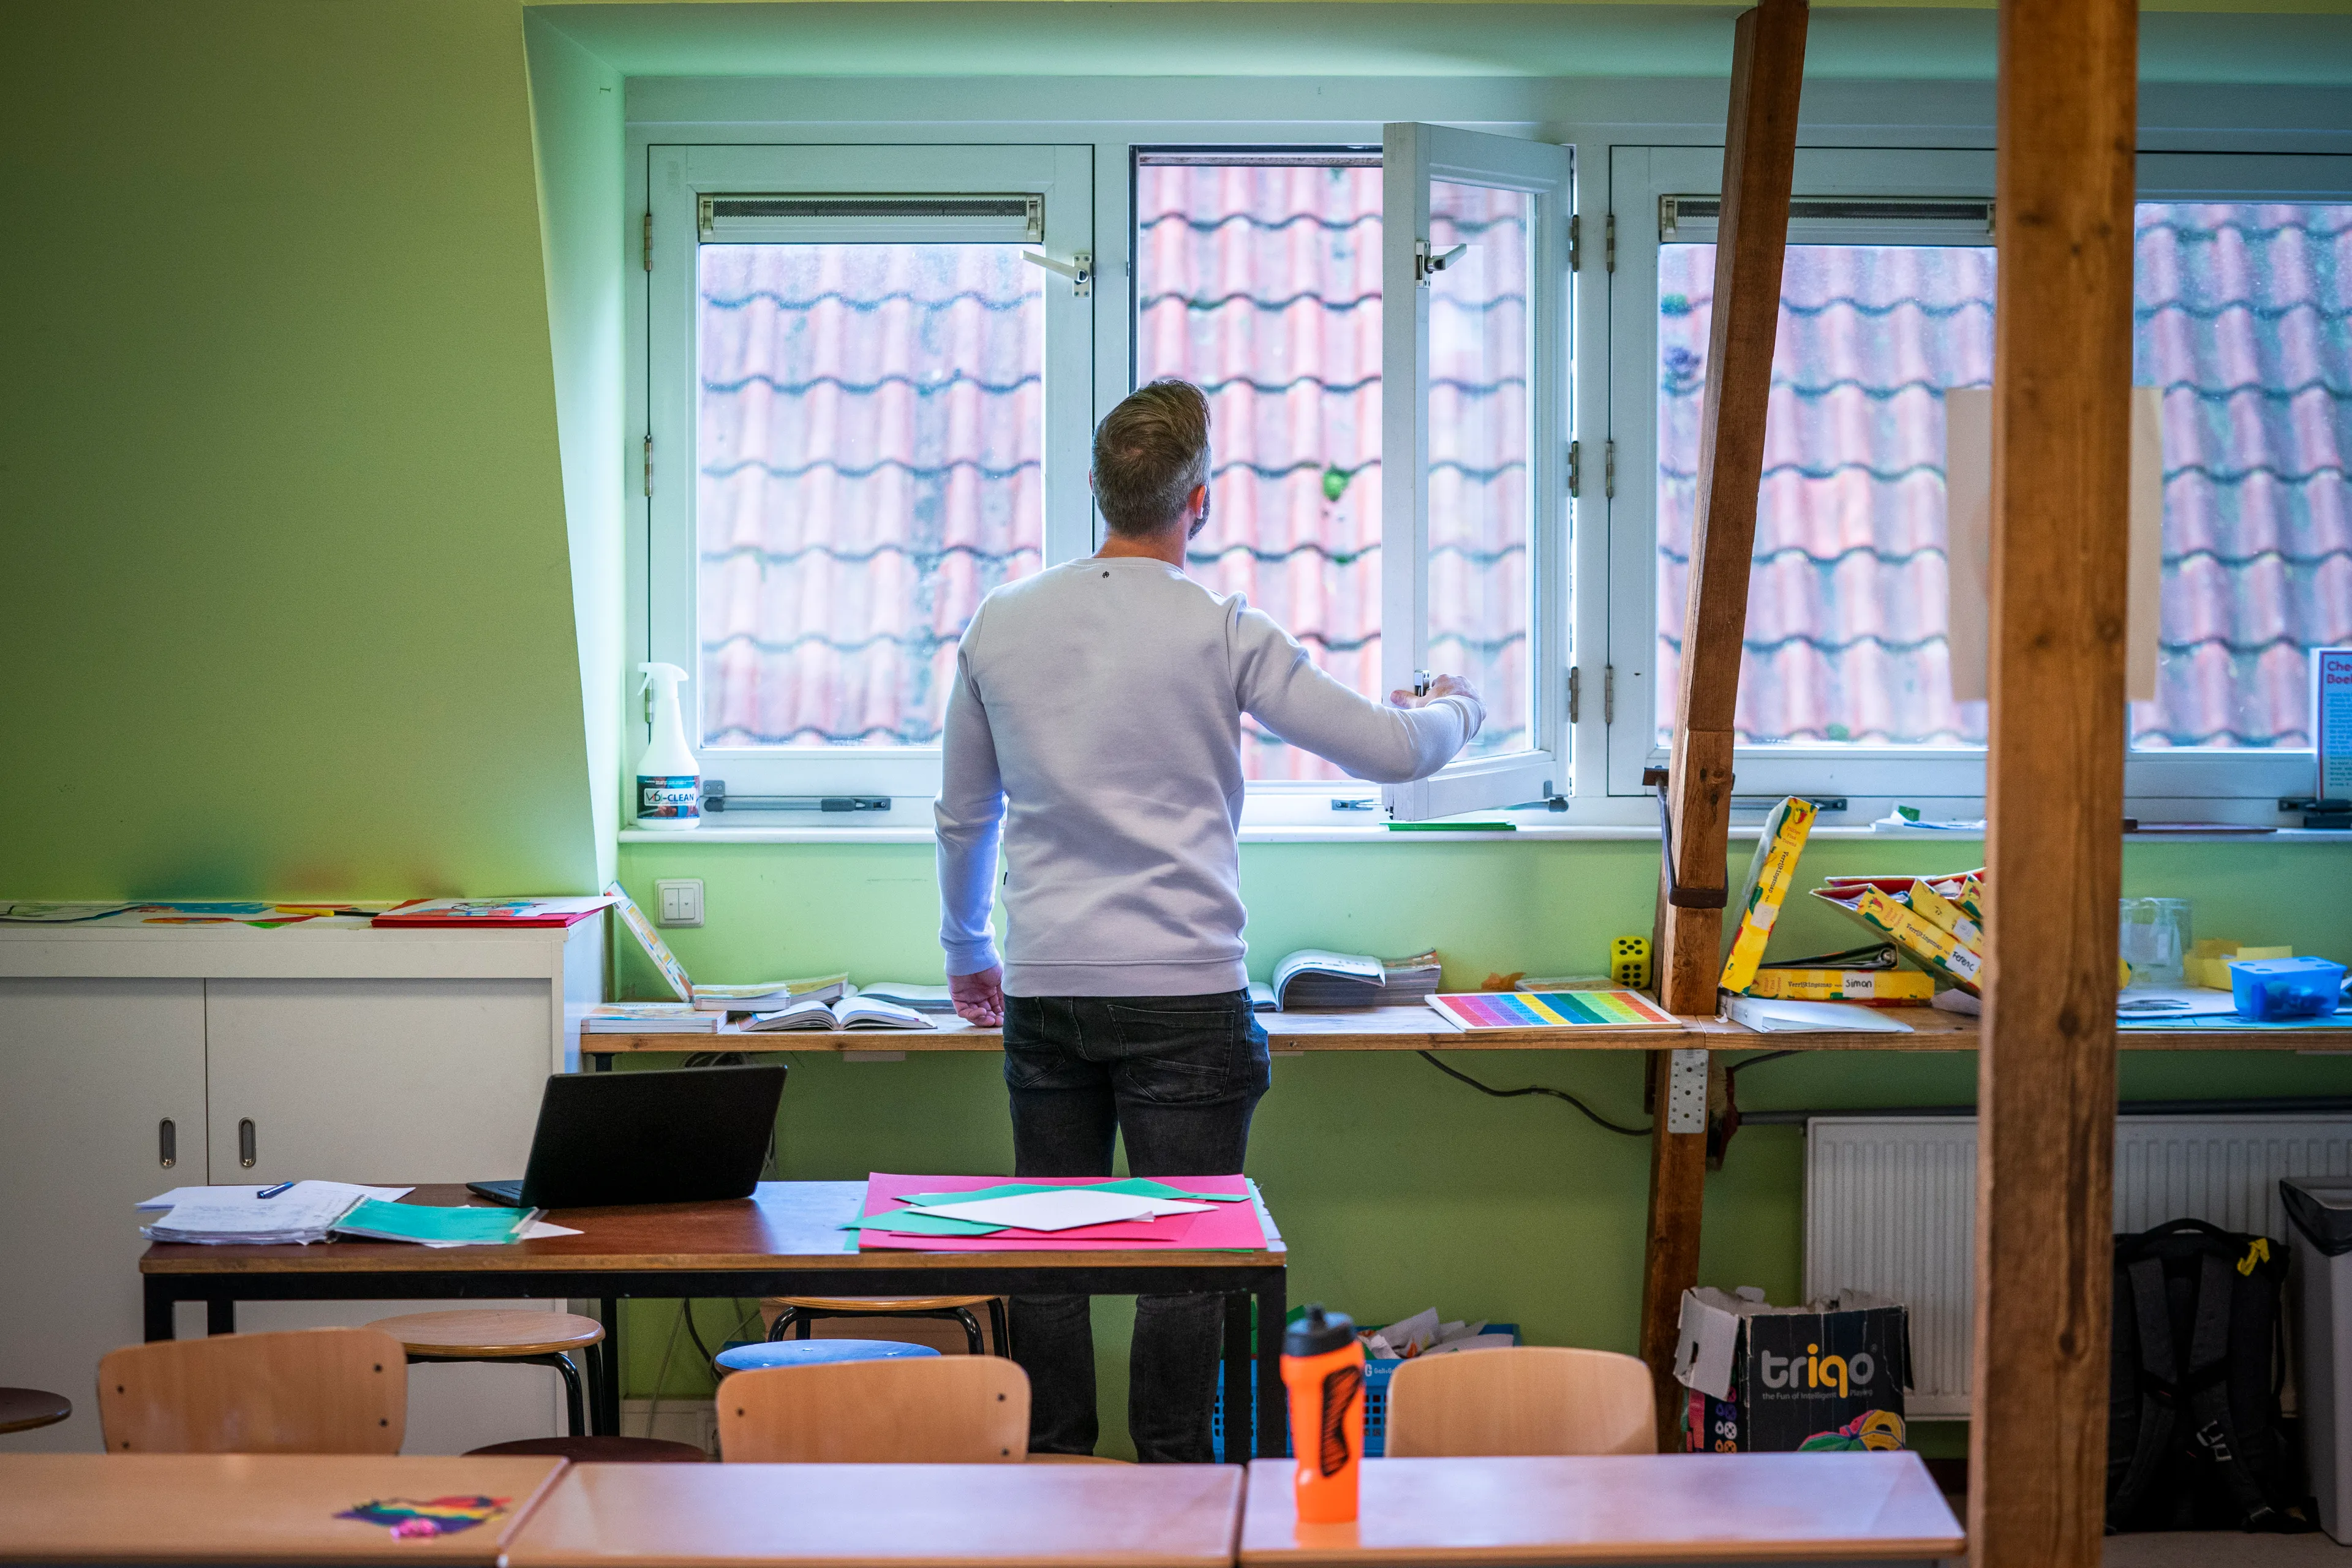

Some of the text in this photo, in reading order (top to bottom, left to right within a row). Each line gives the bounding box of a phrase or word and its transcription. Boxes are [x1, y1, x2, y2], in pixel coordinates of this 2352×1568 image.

[2328, 661, 2352, 671] Che
[2327, 674, 2352, 684] Boe
[1845, 979, 1872, 988] Simon
[1762, 1392, 1775, 1400] the
[1801, 1391, 1837, 1401] Intelligent
